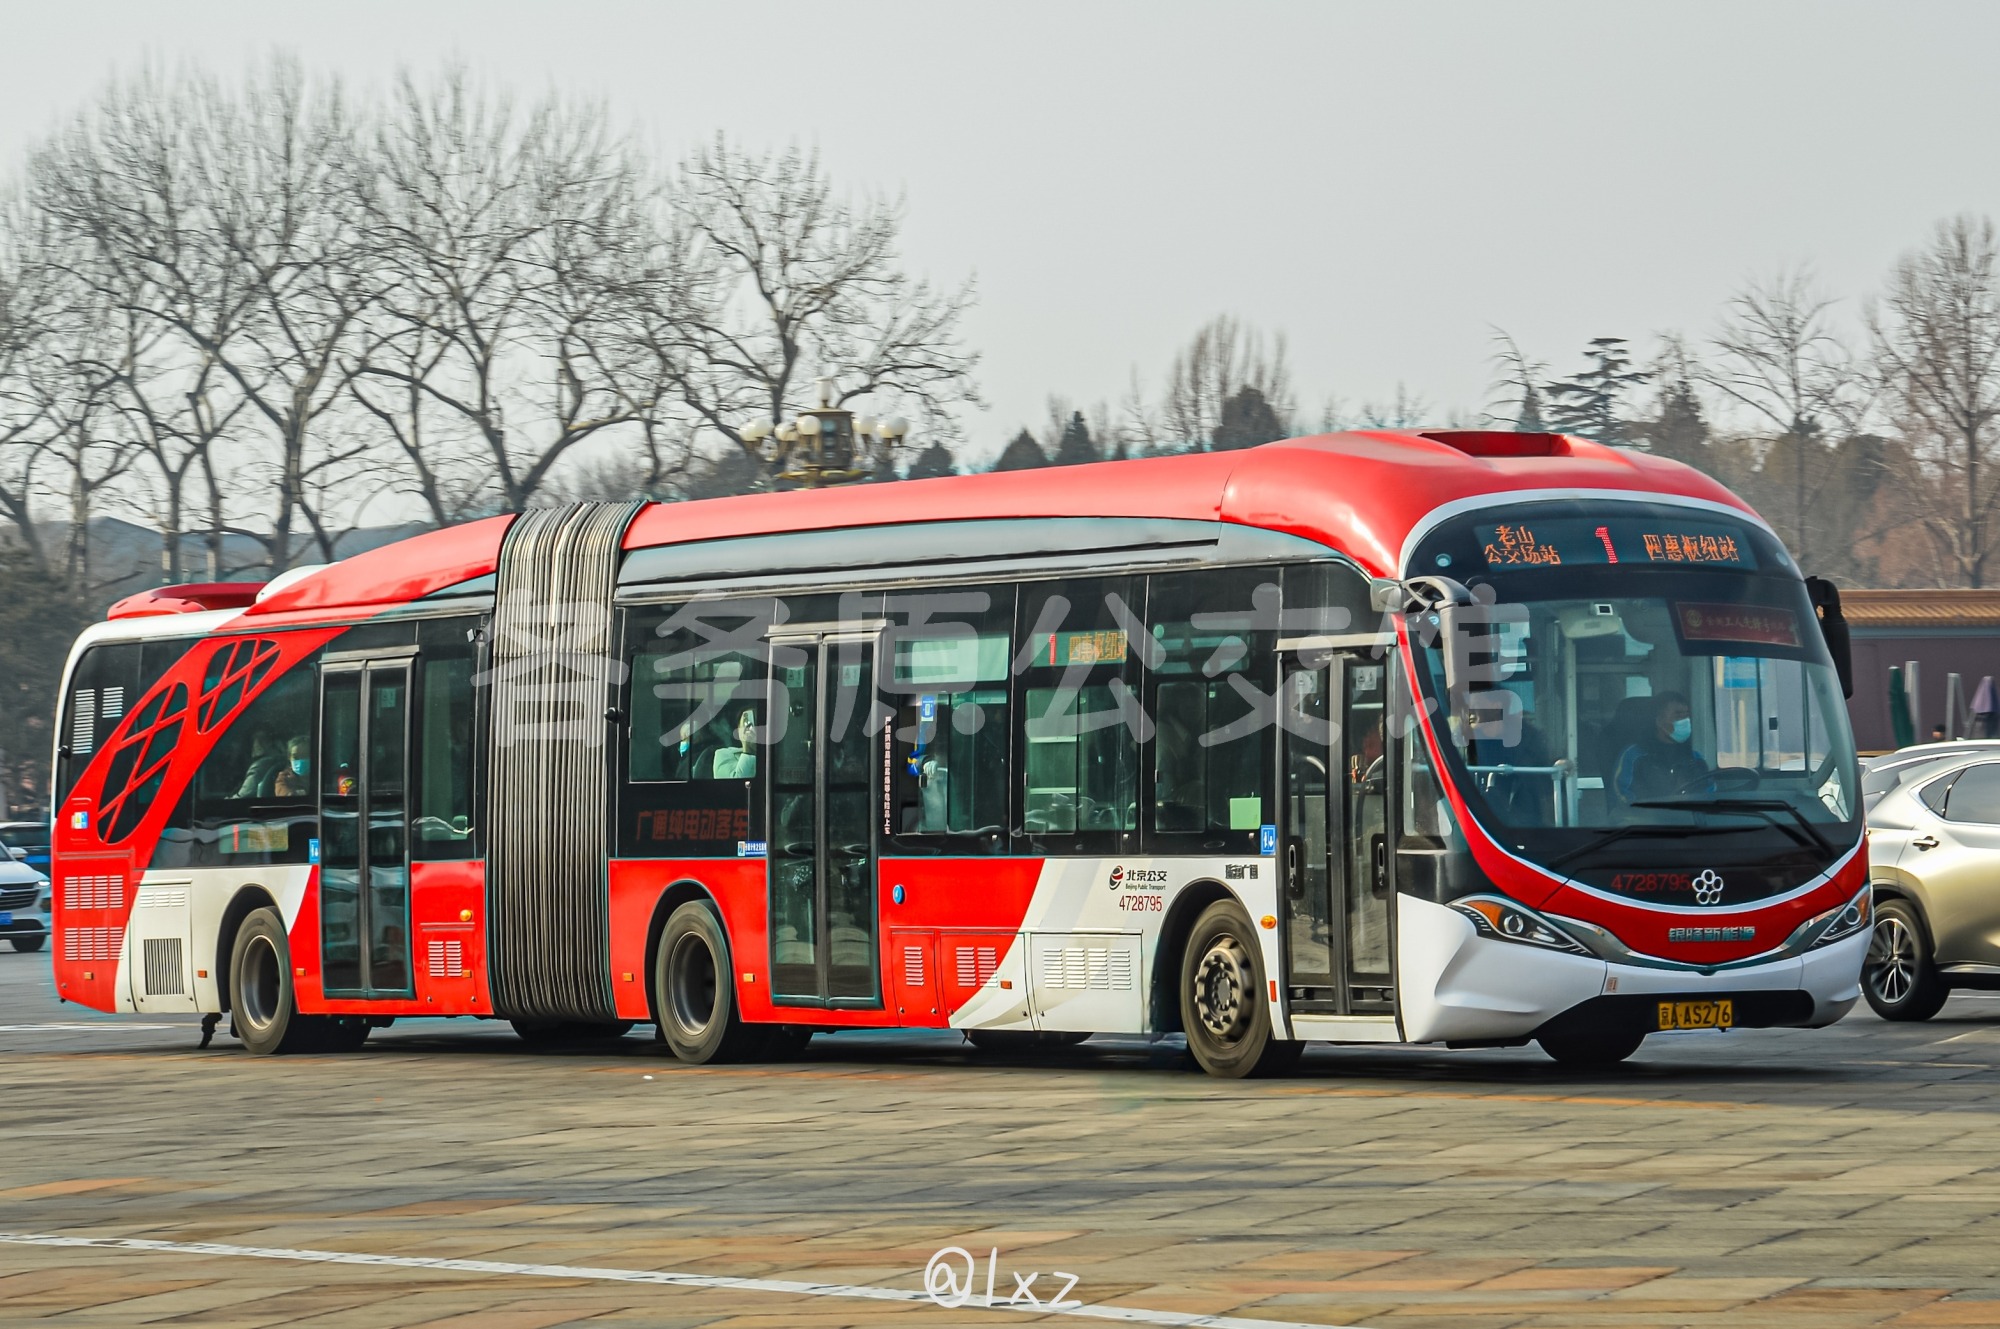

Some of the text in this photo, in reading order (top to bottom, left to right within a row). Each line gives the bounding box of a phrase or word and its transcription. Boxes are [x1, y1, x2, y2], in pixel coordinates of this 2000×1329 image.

[1495, 525, 1535, 545] 老山
[1594, 526, 1619, 564] 1
[1483, 543, 1562, 565] 公交场站
[1643, 534, 1739, 562] 四惠枢纽站
[1050, 634, 1056, 664] 1
[1126, 869, 1168, 882] 北京公交
[1610, 873, 1692, 892] 4728795
[1125, 883, 1137, 891] Beijing
[1119, 895, 1163, 912] 4728795
